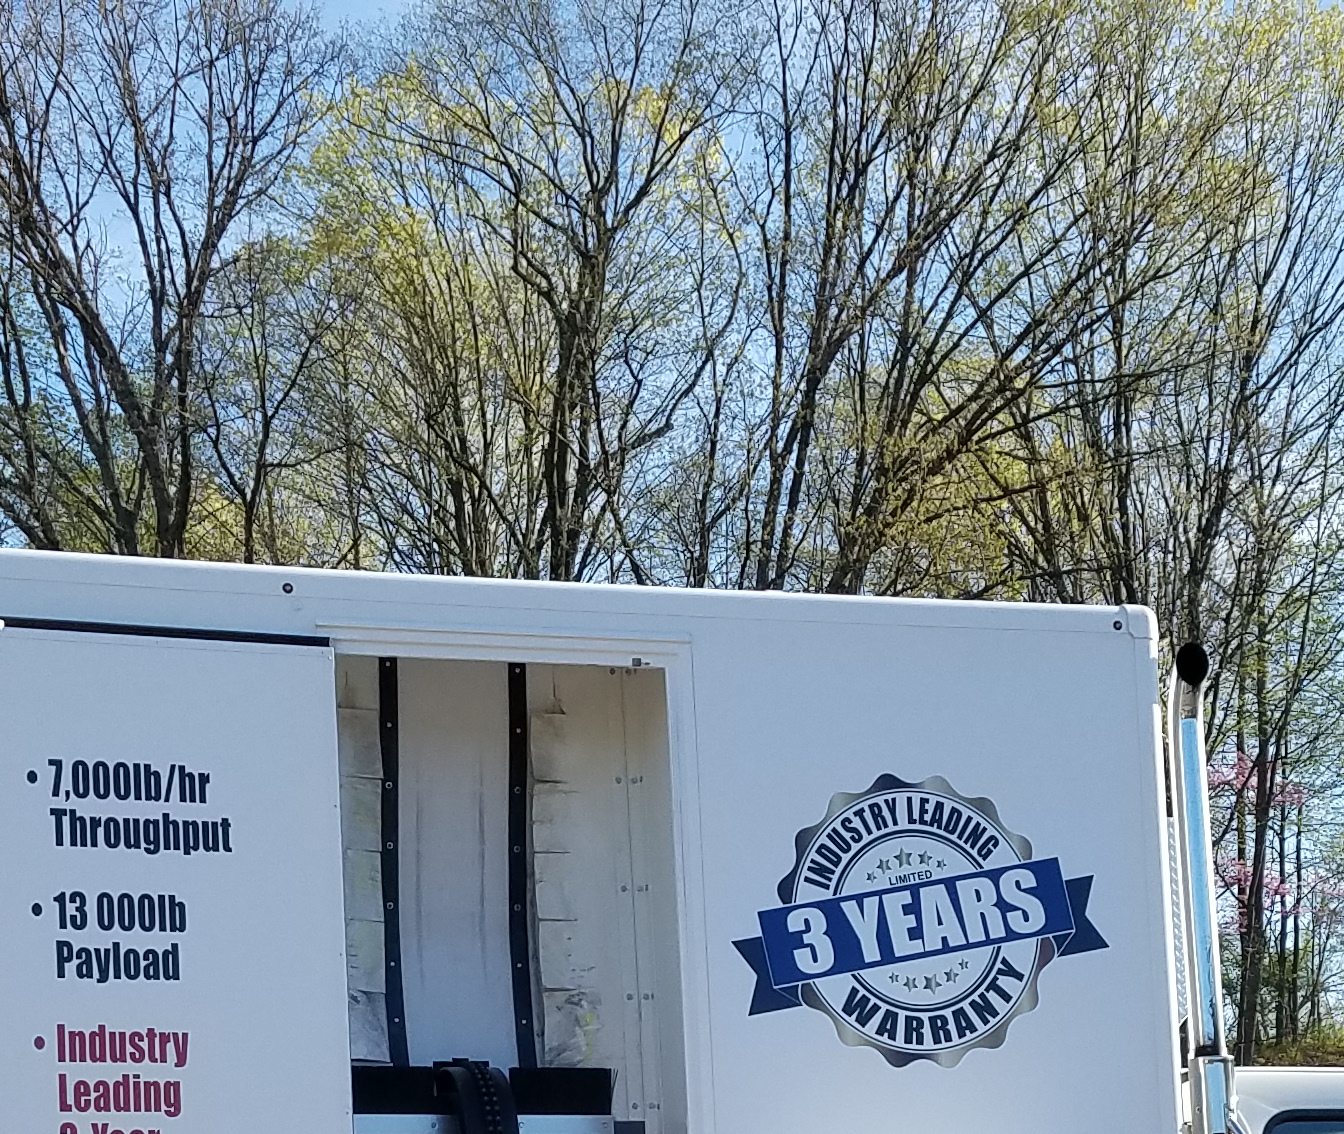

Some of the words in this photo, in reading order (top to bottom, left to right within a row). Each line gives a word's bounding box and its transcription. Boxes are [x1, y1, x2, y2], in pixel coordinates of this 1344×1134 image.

[47, 759, 211, 804] 7,000lb/hr
[49, 807, 233, 856] Throughput
[803, 796, 900, 891] INDUSTRY
[906, 796, 1001, 862] LEADING
[888, 870, 933, 886] LIMITED
[786, 907, 835, 975] 3
[840, 868, 1046, 963] YEARS
[56, 940, 180, 984] Payload
[841, 956, 1026, 1046] WARRANTY
[57, 1024, 190, 1067] Industry
[58, 1074, 182, 1117] Leading
